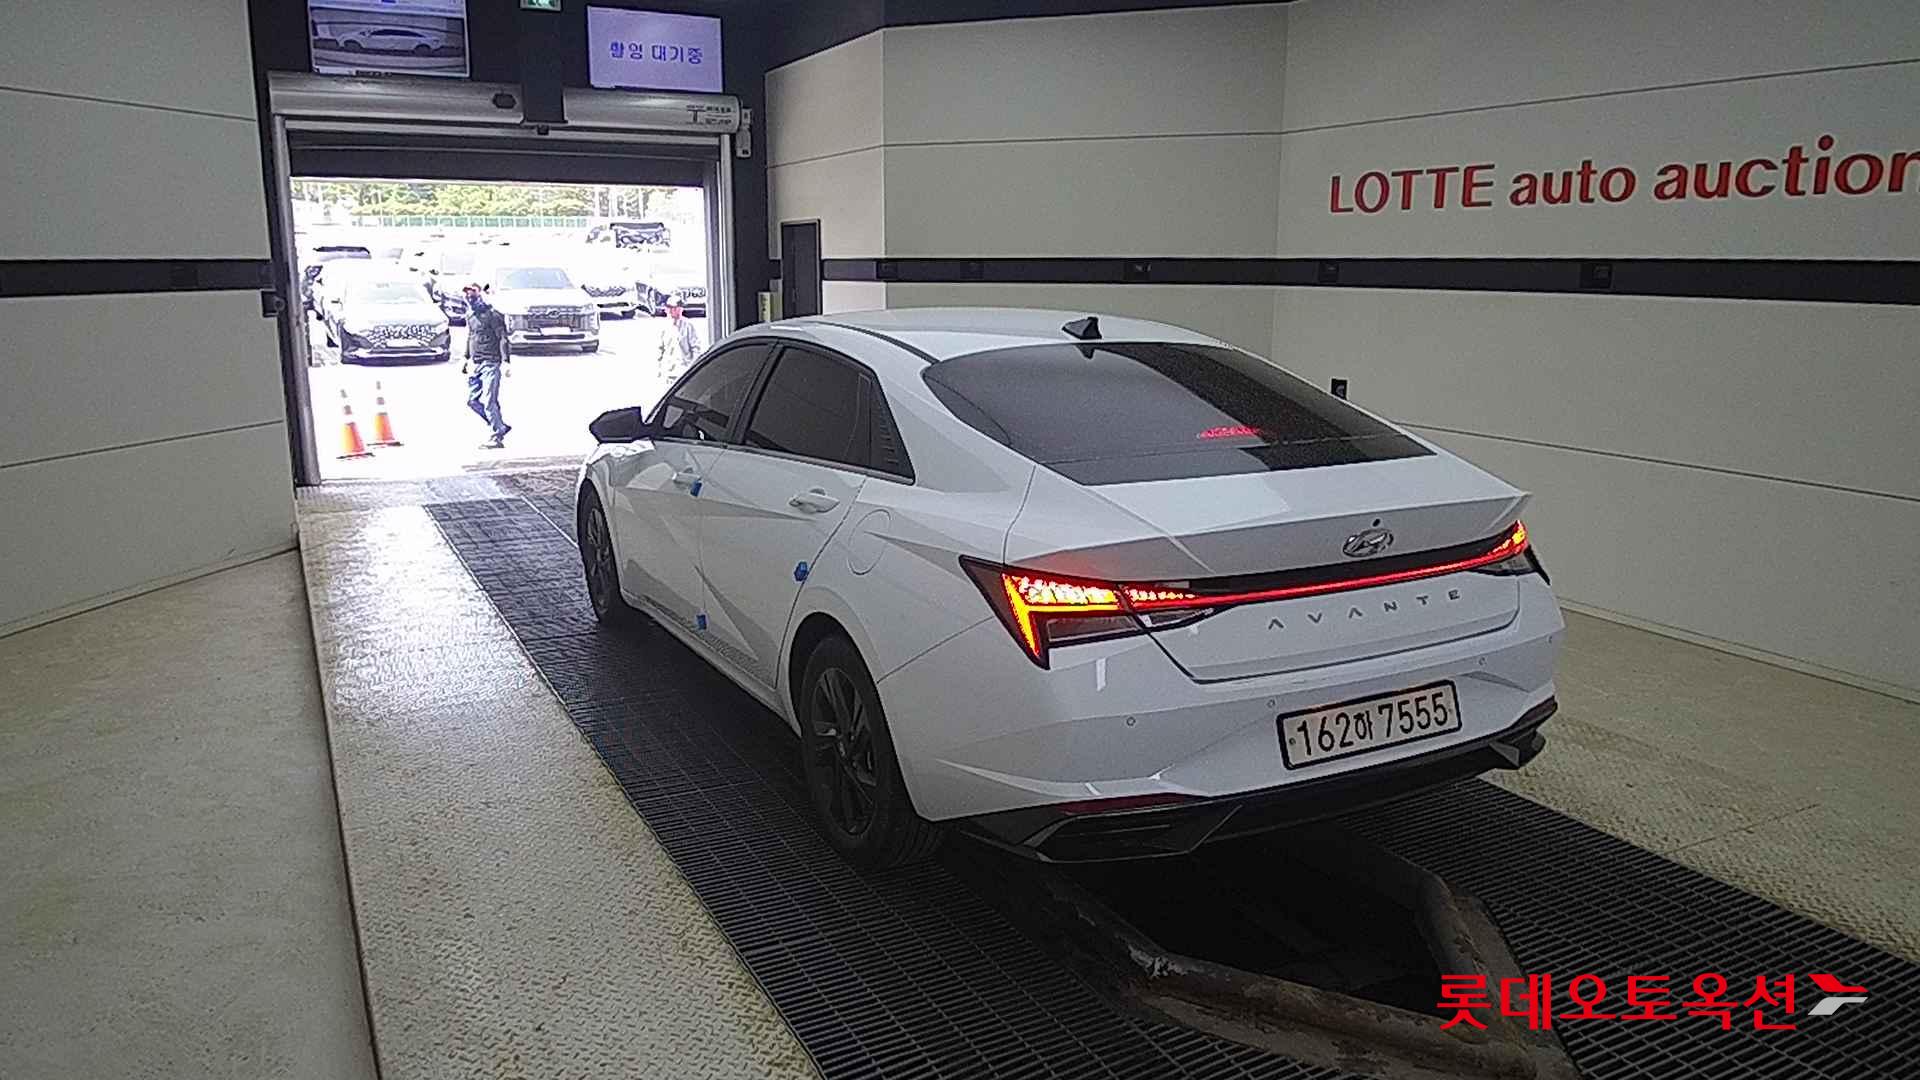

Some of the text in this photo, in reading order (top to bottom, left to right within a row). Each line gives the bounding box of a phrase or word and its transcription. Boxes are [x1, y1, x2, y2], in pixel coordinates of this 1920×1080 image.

[652, 44, 703, 65] 대기중
[1331, 164, 1495, 213] LOTTE
[1511, 159, 1636, 205] auto
[1267, 589, 1460, 630] AVANTE
